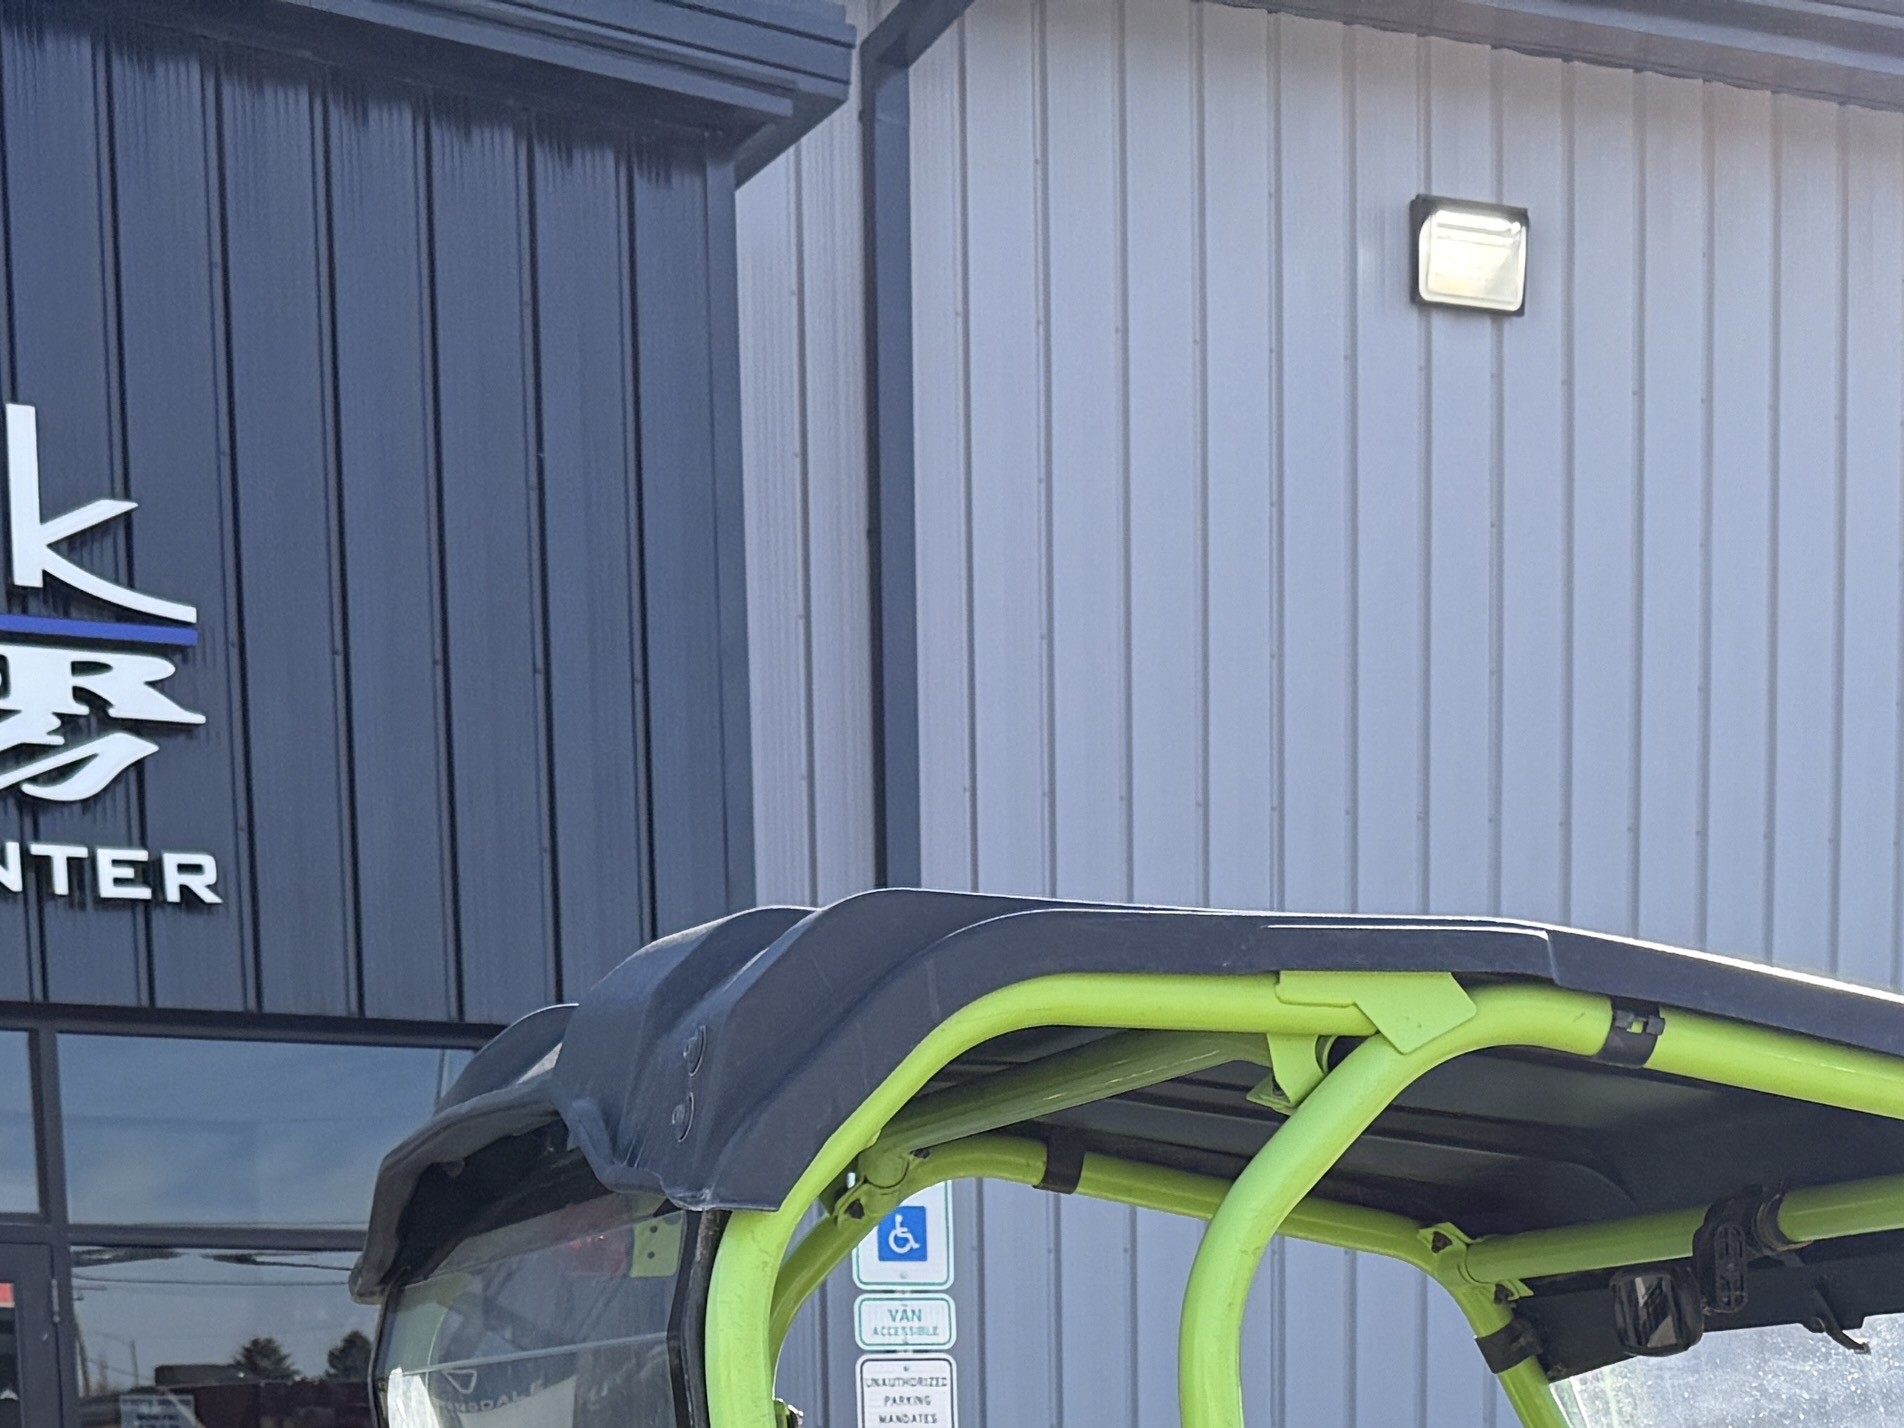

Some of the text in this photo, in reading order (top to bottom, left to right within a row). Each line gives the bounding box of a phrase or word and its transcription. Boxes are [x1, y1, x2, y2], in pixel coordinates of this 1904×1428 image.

[887, 1309, 922, 1322] VAN
[873, 1326, 939, 1337] ACCESSIBLE
[865, 1377, 948, 1388] UNAUTHORIZED
[883, 1395, 931, 1406] PARKING
[879, 1413, 938, 1424] MANDATES
